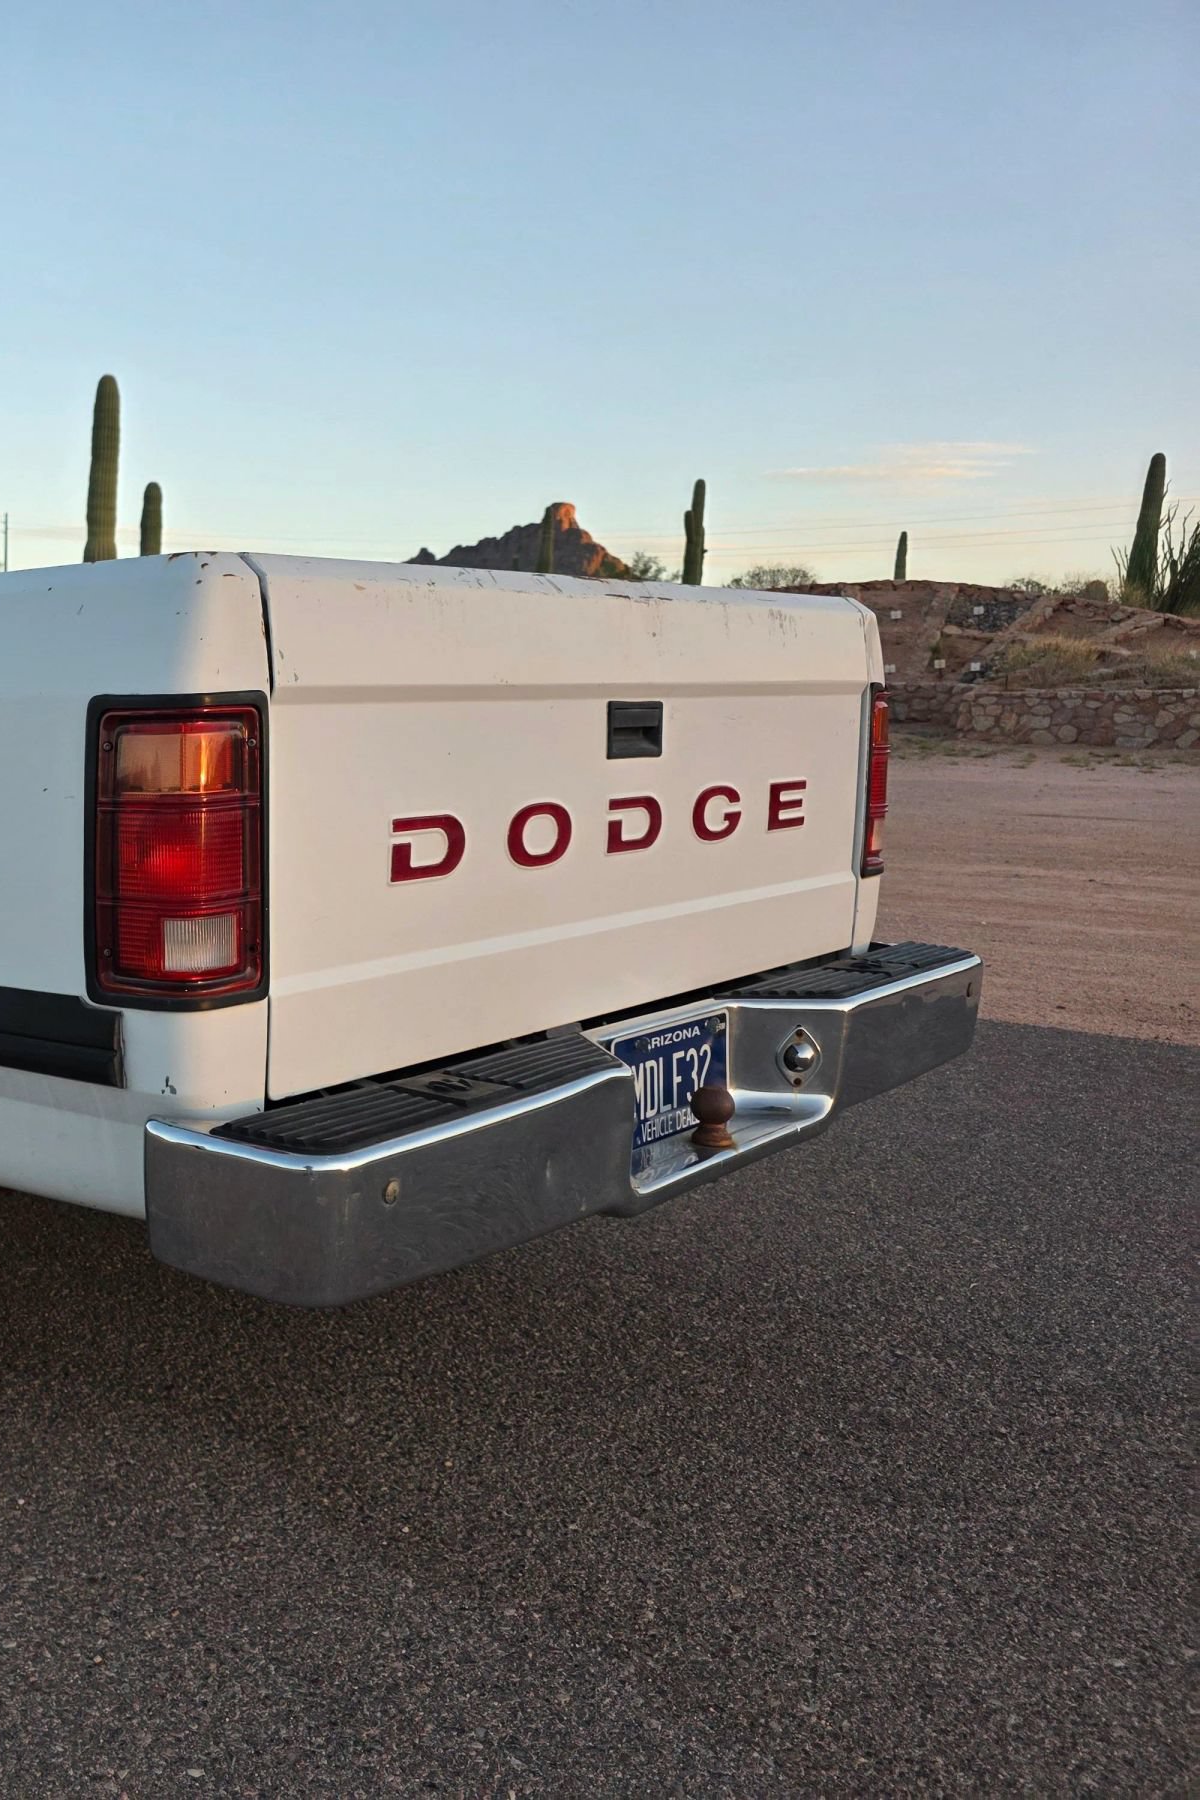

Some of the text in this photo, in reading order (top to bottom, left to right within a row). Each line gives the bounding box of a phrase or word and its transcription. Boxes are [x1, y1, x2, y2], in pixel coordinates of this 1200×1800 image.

[389, 779, 807, 883] DODGE
[647, 1026, 701, 1050] RIZONA
[641, 1107, 701, 1142] VEHICLE DEAL
